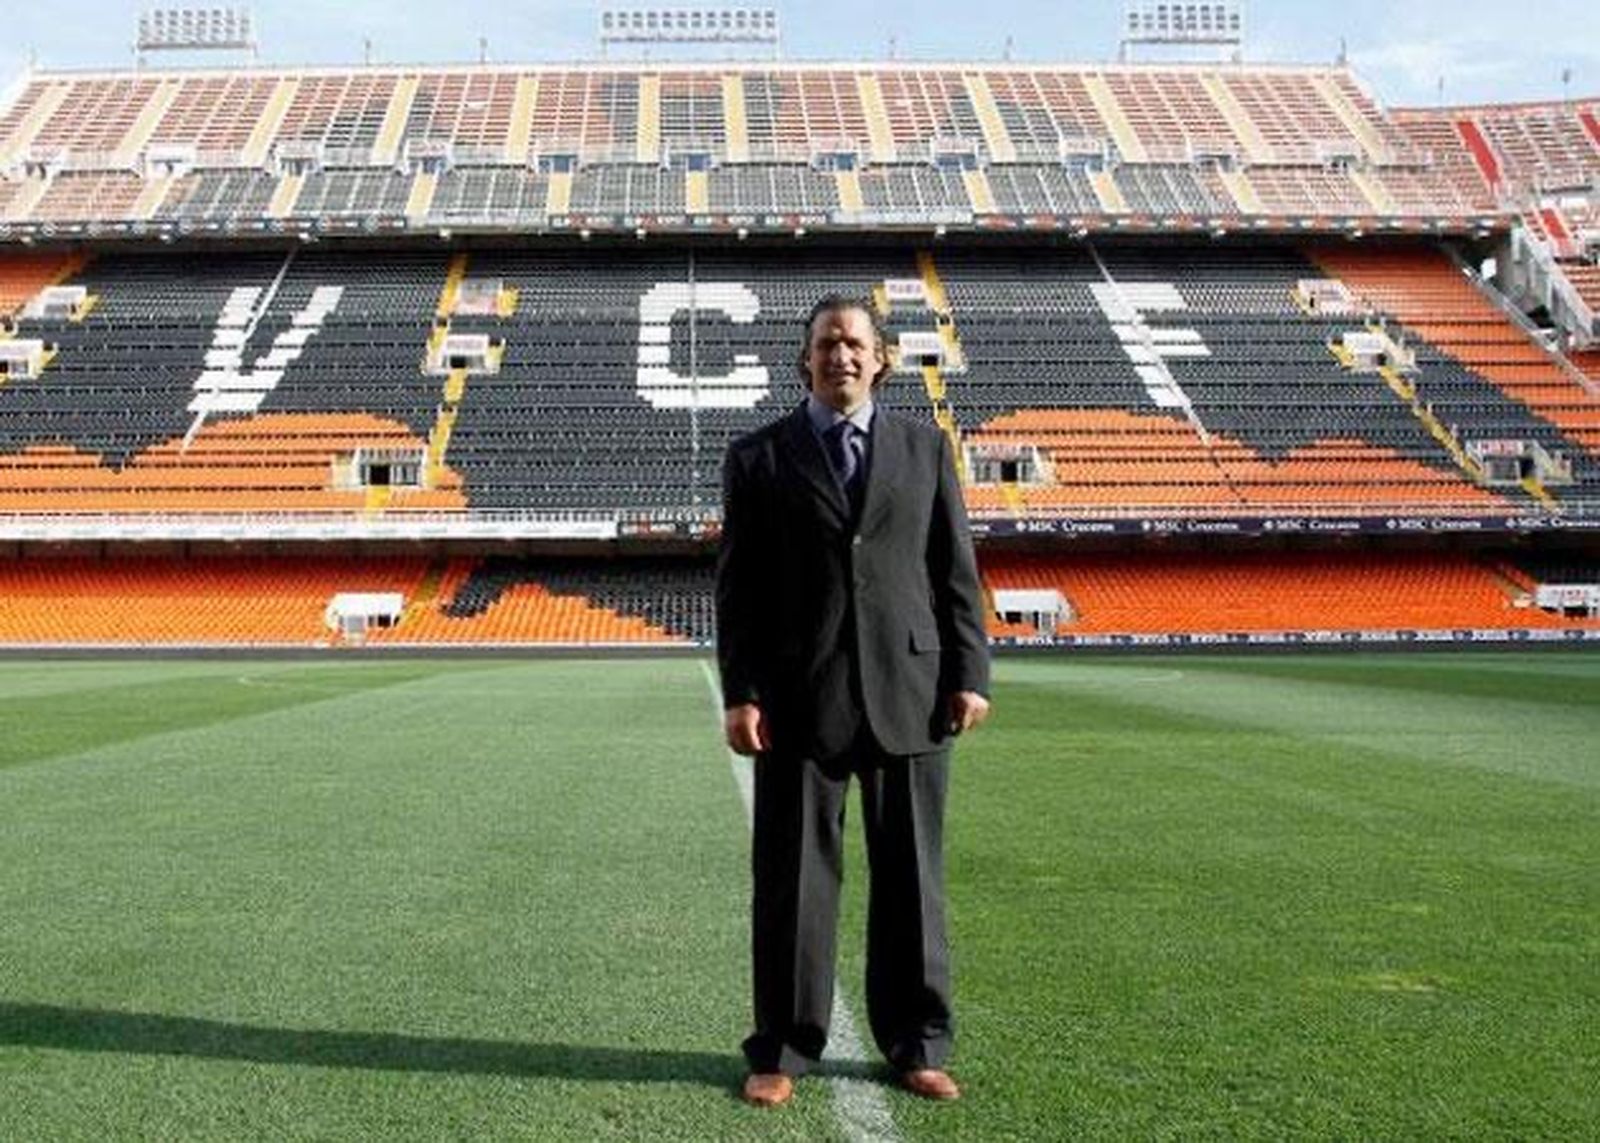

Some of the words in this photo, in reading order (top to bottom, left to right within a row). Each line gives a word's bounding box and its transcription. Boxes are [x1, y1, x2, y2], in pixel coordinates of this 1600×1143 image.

[186, 286, 345, 411] V
[636, 281, 771, 408] C
[1089, 282, 1213, 407] F
